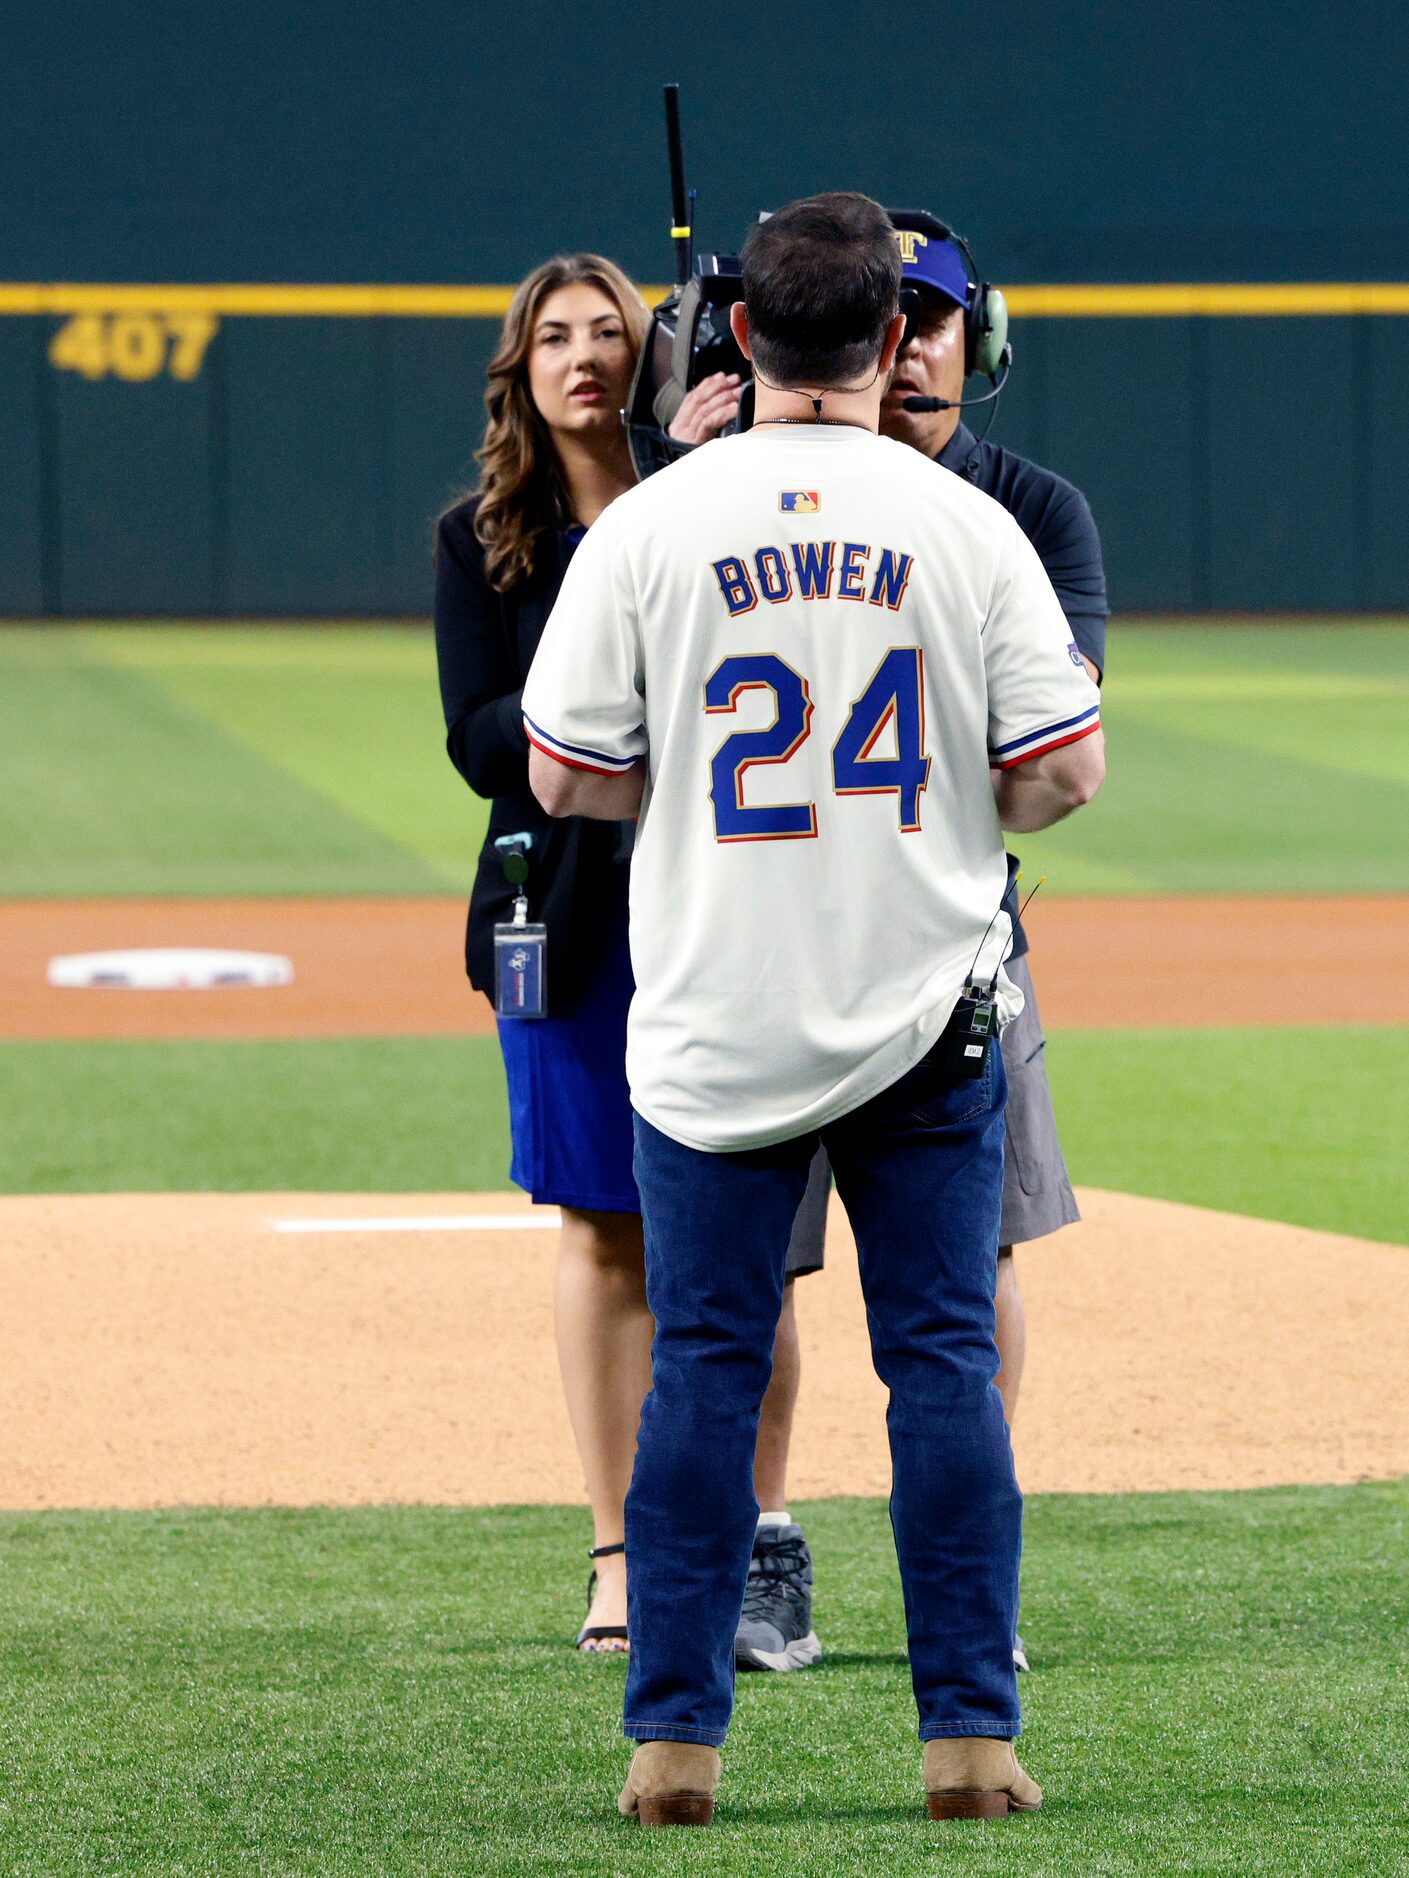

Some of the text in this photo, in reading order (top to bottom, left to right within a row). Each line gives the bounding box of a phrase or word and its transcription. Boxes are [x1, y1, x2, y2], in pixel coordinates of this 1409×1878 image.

[895, 230, 928, 265] T
[48, 308, 221, 383] 407
[709, 541, 914, 618] BOWEN
[702, 645, 932, 844] 24
